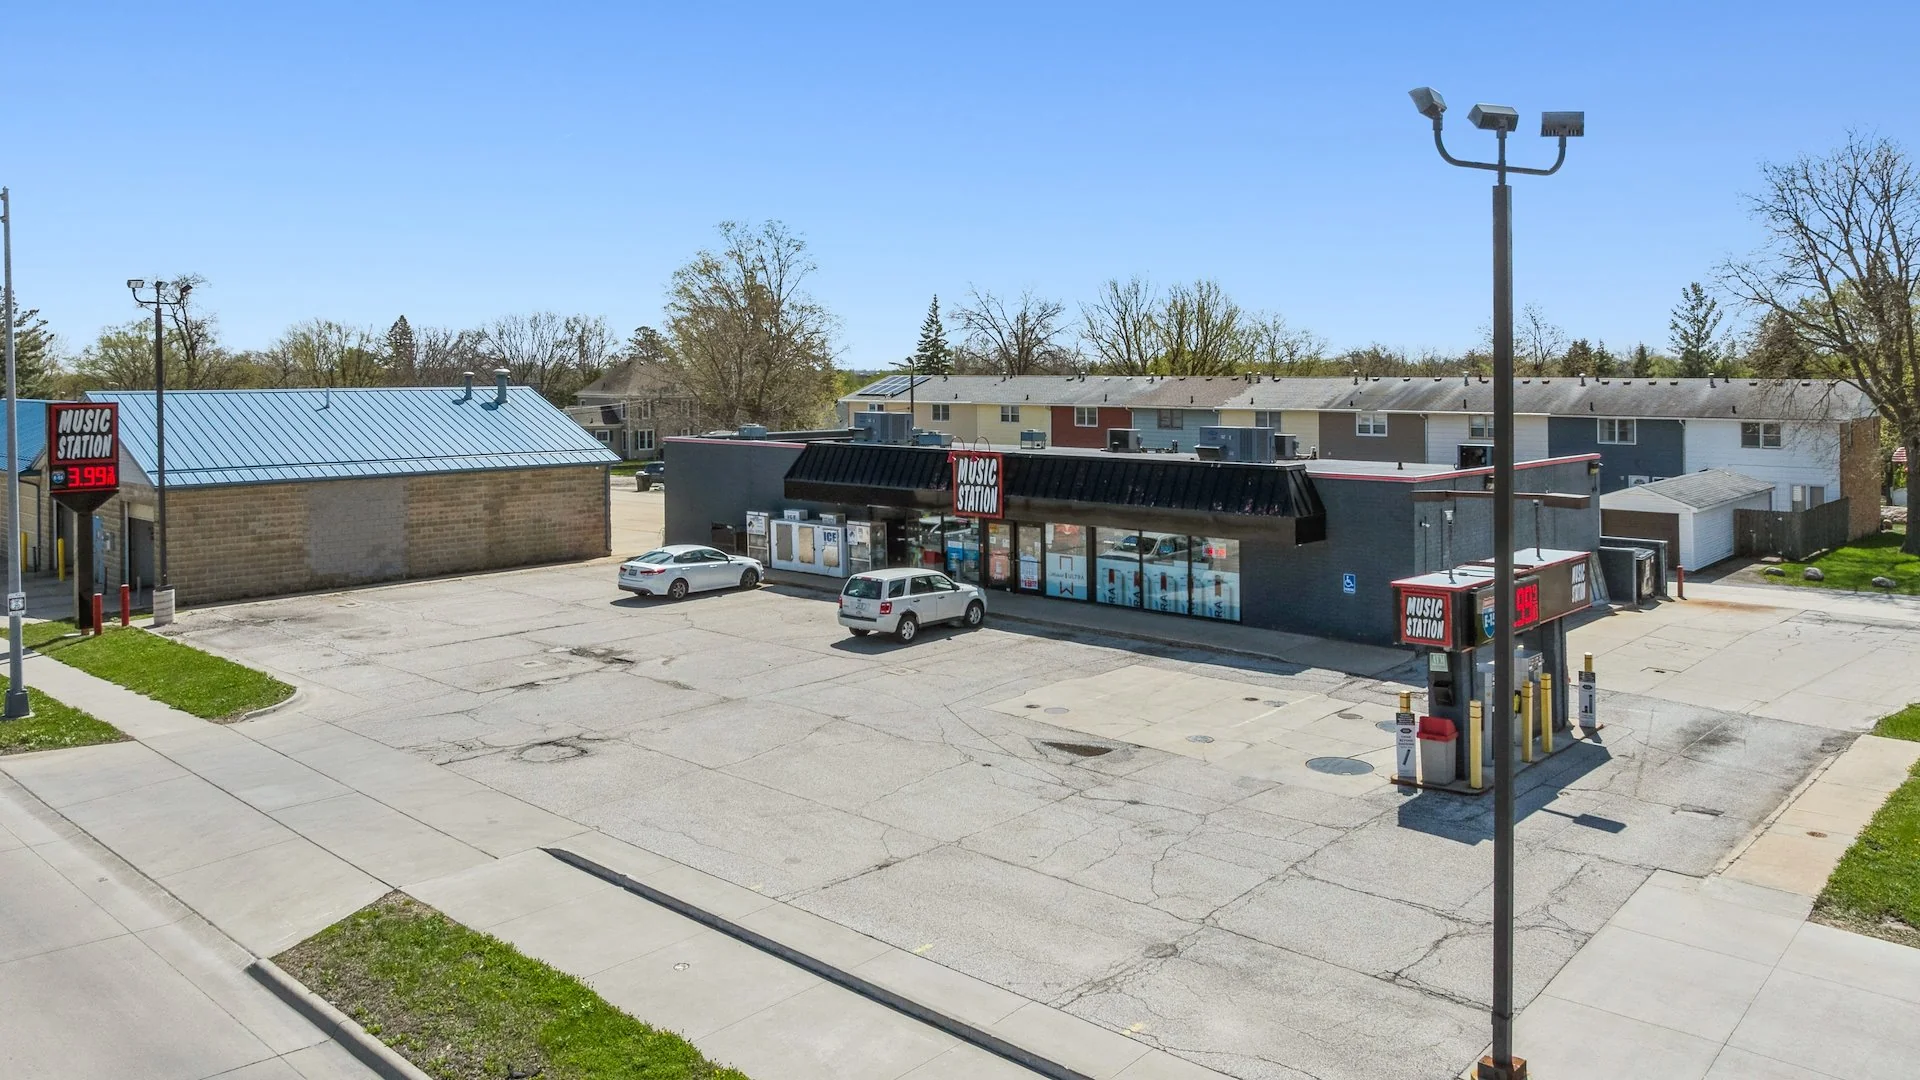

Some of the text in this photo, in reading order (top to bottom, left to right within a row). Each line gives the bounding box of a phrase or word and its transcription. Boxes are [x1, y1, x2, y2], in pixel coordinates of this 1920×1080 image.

[58, 408, 111, 433] MUSIC
[57, 434, 112, 459] STATION
[957, 457, 997, 486] MUSIC
[957, 484, 998, 513] STATION
[823, 532, 837, 542] ICE
[1406, 596, 1443, 619] MUSIC
[1405, 617, 1445, 640] STATION
